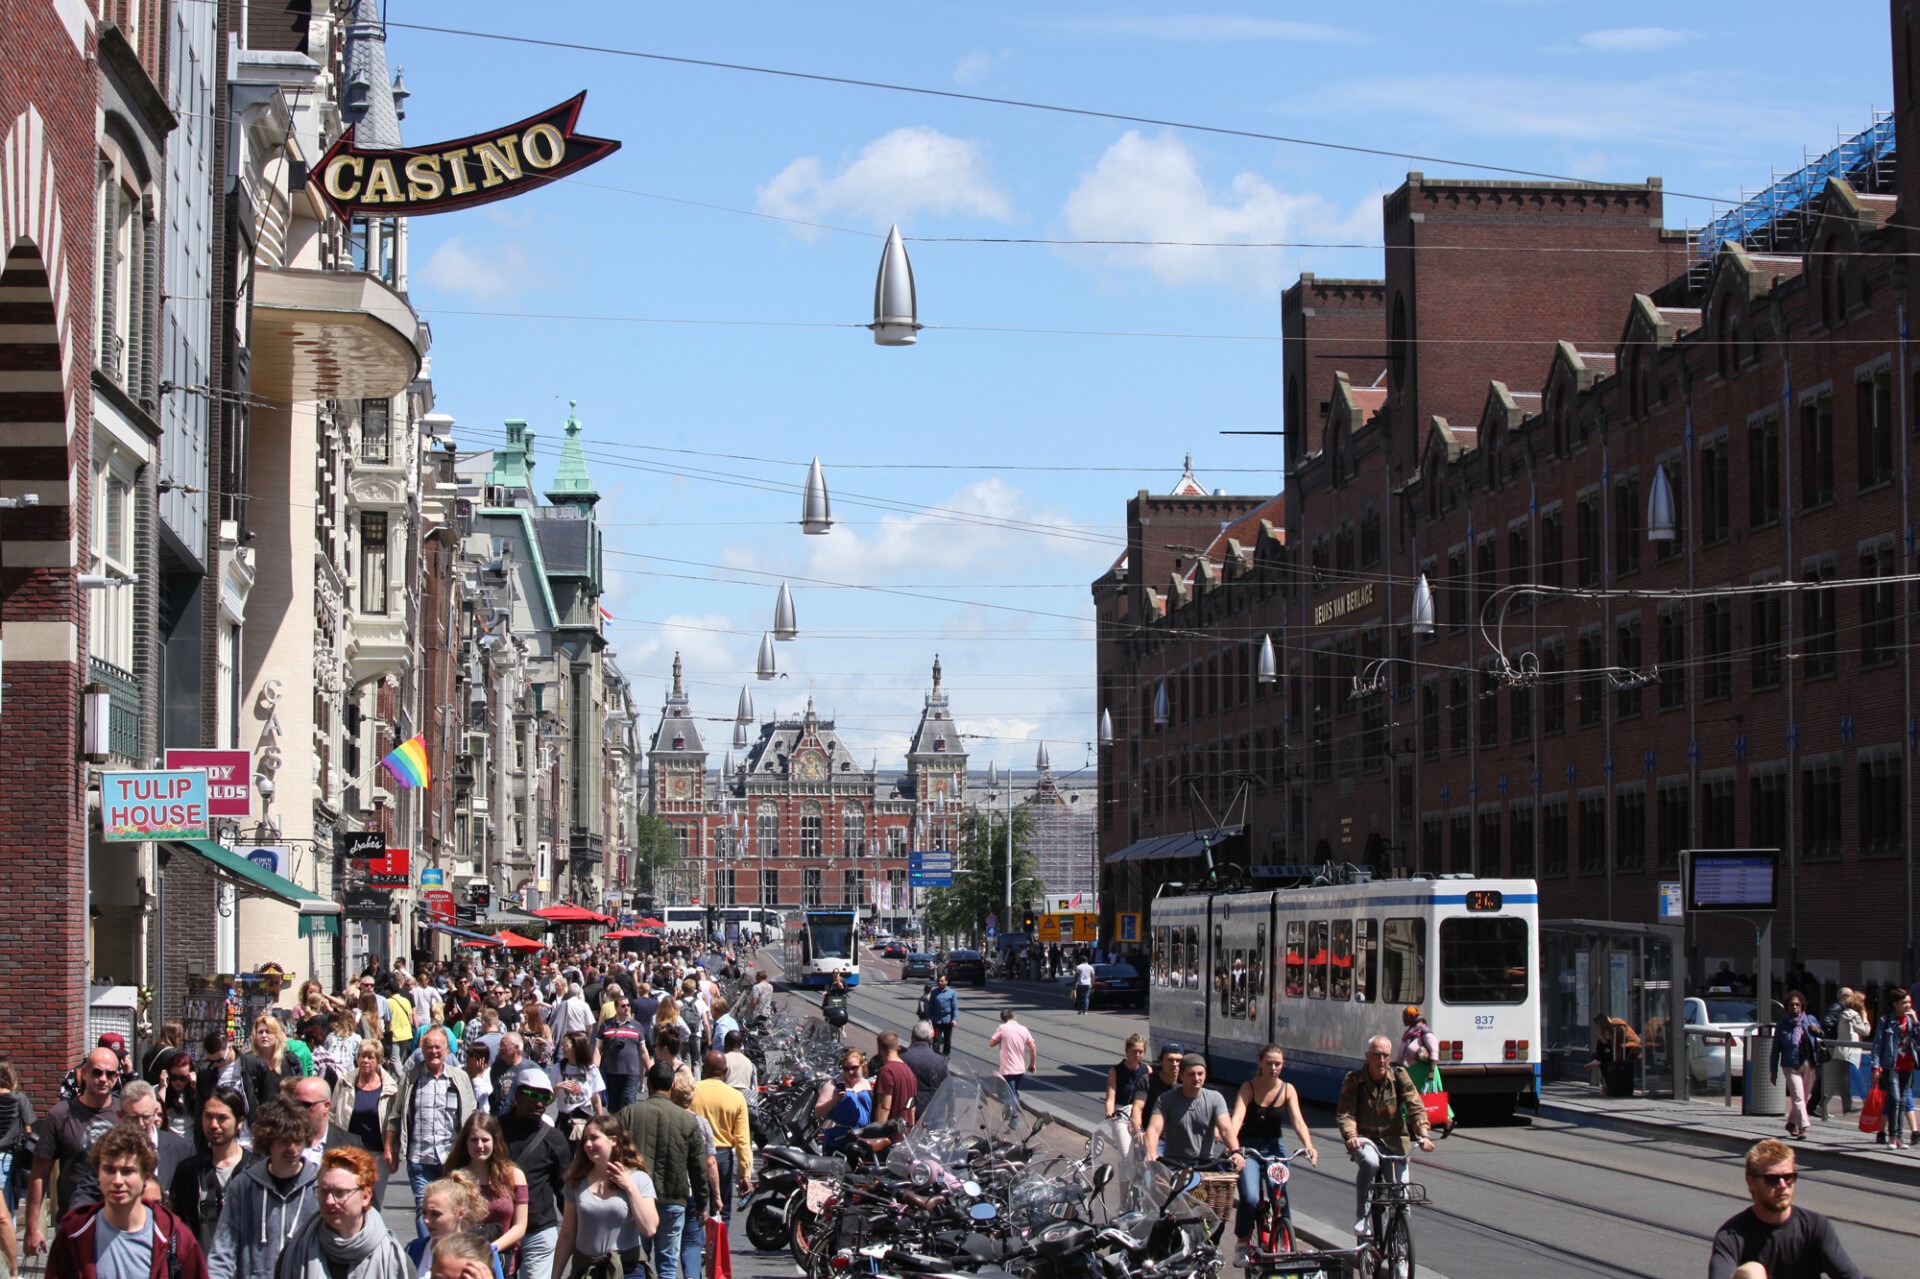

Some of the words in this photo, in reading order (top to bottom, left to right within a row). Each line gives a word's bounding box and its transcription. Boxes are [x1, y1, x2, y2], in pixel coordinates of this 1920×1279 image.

[324, 123, 566, 203] CASINO
[117, 779, 192, 800] TULIP
[207, 785, 248, 799] RLDS
[111, 804, 203, 827] HOUSE
[1474, 1015, 1495, 1025] 837
